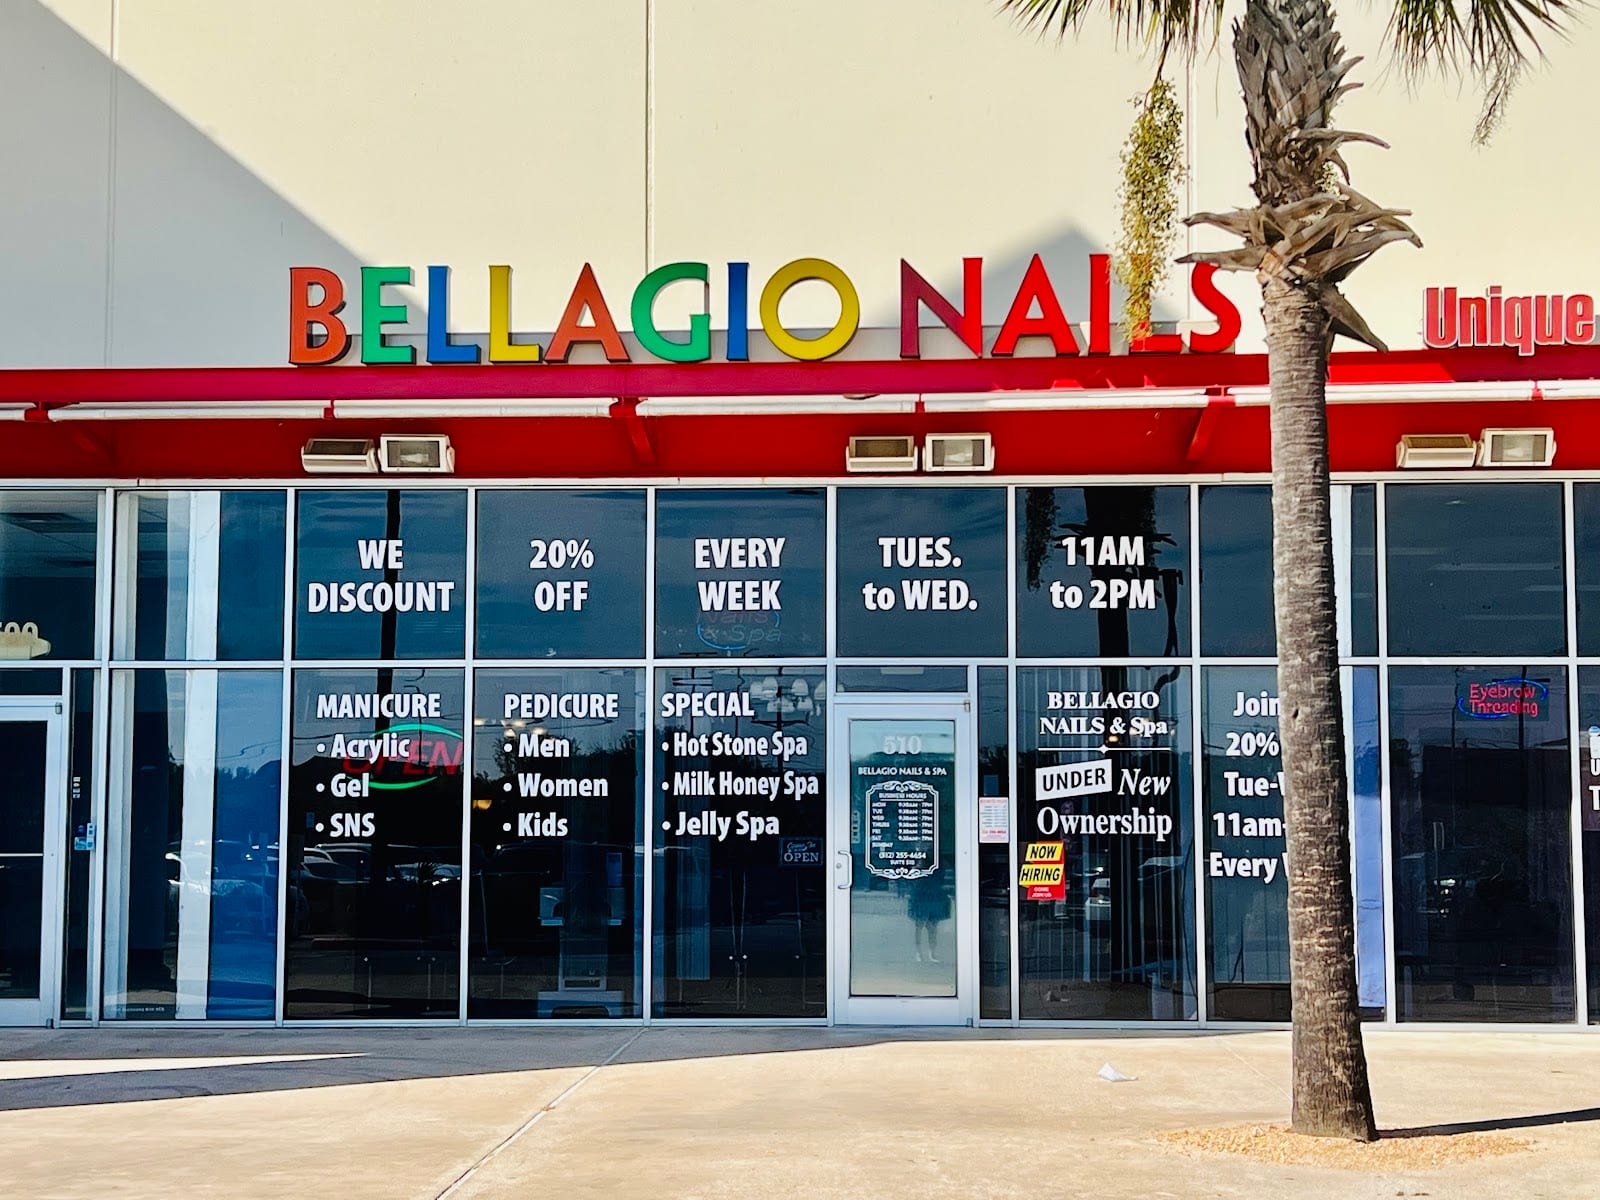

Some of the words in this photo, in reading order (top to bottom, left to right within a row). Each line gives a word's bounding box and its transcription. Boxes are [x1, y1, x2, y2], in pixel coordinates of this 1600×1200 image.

[289, 257, 861, 366] BELLAGIO
[1424, 284, 1597, 356] Unique
[358, 539, 404, 569] WE
[529, 539, 595, 569] 20%
[694, 537, 786, 569] EVERY
[878, 536, 962, 568] TUES.
[1061, 535, 1145, 566] 11AM
[308, 581, 455, 613] DISCOUNT
[534, 580, 589, 612] OFF
[698, 579, 782, 611] WEEK
[862, 581, 895, 611] to
[902, 579, 978, 611] WED.
[1050, 580, 1083, 609] to
[1089, 578, 1156, 609] 2PM
[316, 693, 441, 718] MANICURE
[504, 693, 619, 718] PEDICURE
[661, 692, 755, 717] SPECIAL
[1047, 691, 1160, 710] BELLAGIO
[1470, 683, 1536, 701] Eyebrow
[1470, 700, 1538, 717] Threading
[1039, 716, 1105, 735] NAILS
[1109, 718, 1126, 735] &
[1130, 717, 1168, 738] Spa
[330, 733, 411, 764] Acrylic
[518, 733, 570, 758] Men
[673, 732, 709, 757] Hot
[712, 732, 768, 757] Stone
[772, 731, 808, 762] Spa
[883, 735, 922, 755] 510
[1225, 732, 1280, 757] 20%
[858, 767, 897, 775] BELLAGIO
[899, 767, 923, 775] NAILS
[924, 767, 931, 775] &
[932, 767, 947, 775] SPA
[1042, 767, 1107, 792] UNDER
[1118, 768, 1171, 796] New
[330, 772, 370, 798] Gel
[518, 773, 609, 797] Women
[673, 771, 716, 796] Milk
[719, 771, 780, 801] Honey
[784, 771, 819, 801] Spa
[330, 812, 376, 837] SNS
[518, 812, 568, 837] Kids
[675, 811, 731, 842] Jelly
[736, 811, 780, 842] Spa
[1037, 807, 1173, 842] Ownership
[1212, 812, 1286, 837] 11am
[783, 852, 820, 862] OPEN
[1030, 845, 1057, 859] NOW
[1021, 867, 1060, 882] HIRING
[1209, 852, 1278, 884] Every
